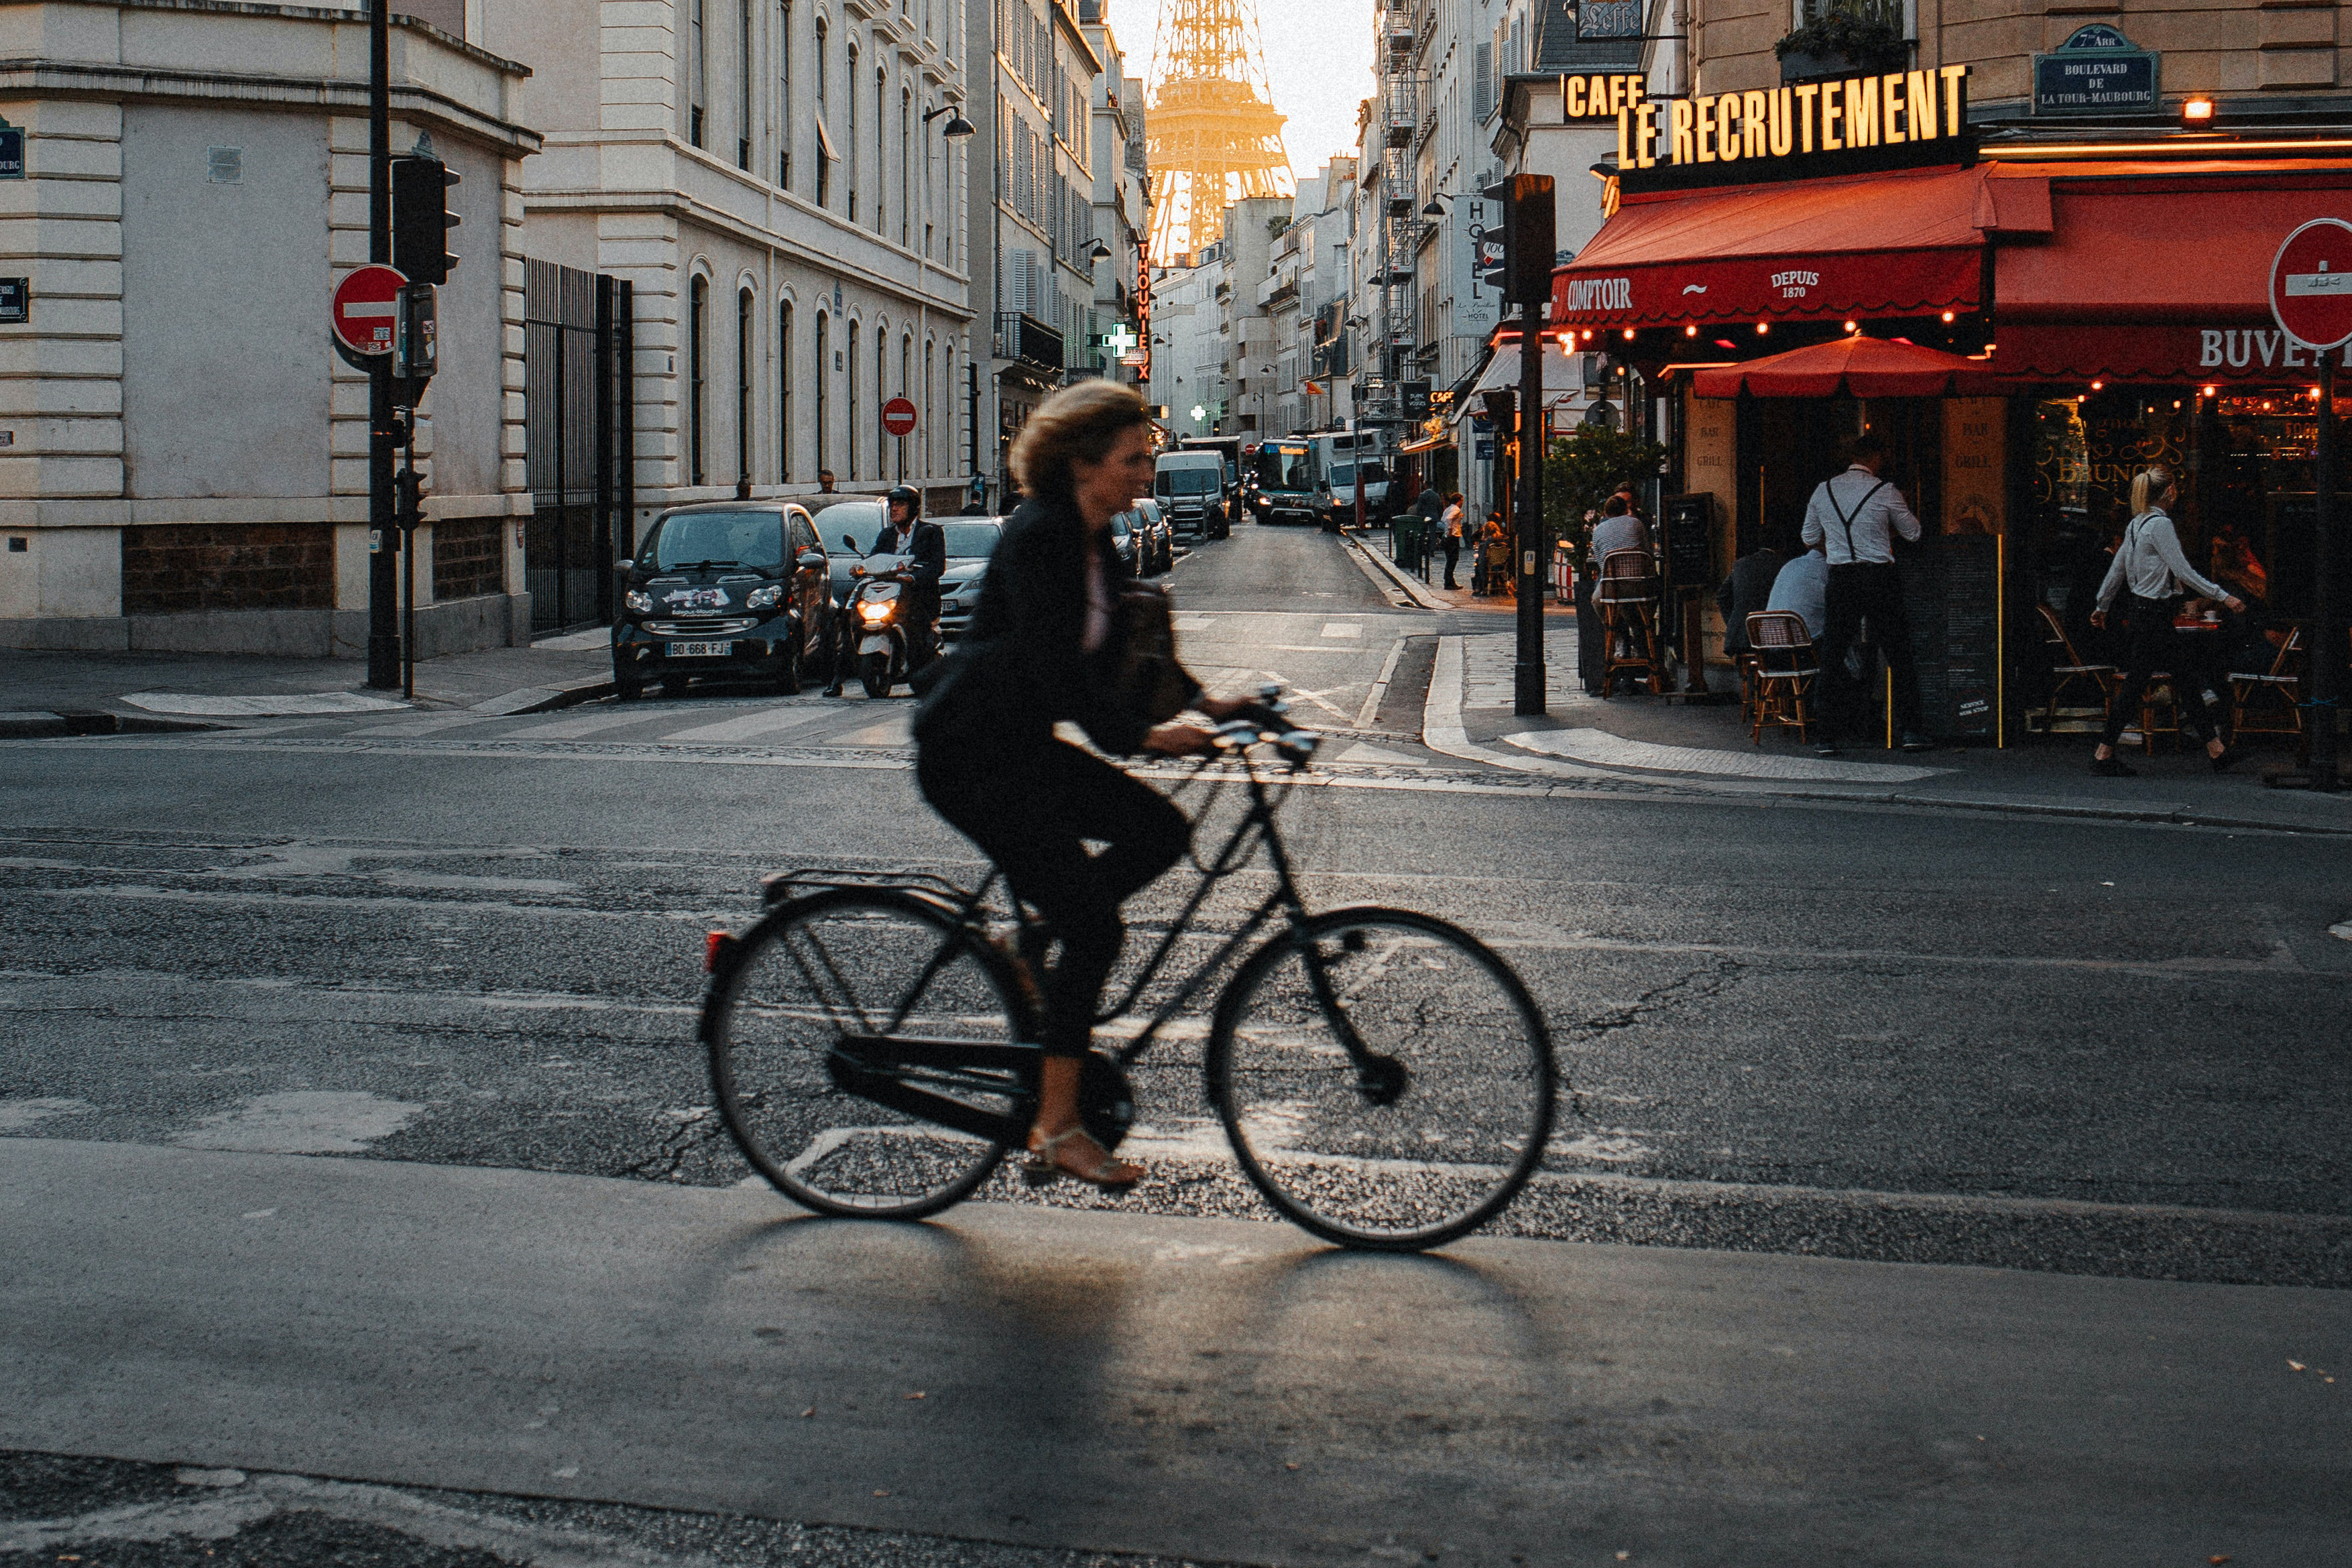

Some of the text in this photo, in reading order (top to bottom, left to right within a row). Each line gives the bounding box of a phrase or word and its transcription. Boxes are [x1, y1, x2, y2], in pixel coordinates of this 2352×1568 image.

[1580, 4, 1639, 35] Leffe
[2065, 64, 2127, 75] BOULEVARD
[2089, 78, 2104, 88] DE
[2041, 91, 2151, 104] LA TOUR-MAUBOURG
[1618, 65, 1966, 170] LE RECRUTEMENT
[1770, 271, 1820, 288] DEPUIS
[1567, 278, 1633, 310] COMPTOIR
[1782, 287, 1806, 298] 1870
[1137, 243, 1150, 379] THOUMIEUX
[2200, 330, 2352, 367] BUVE
[1700, 427, 1719, 438] BAR
[1697, 456, 1723, 467] GRILL
[1955, 455, 1991, 468] GRILL
